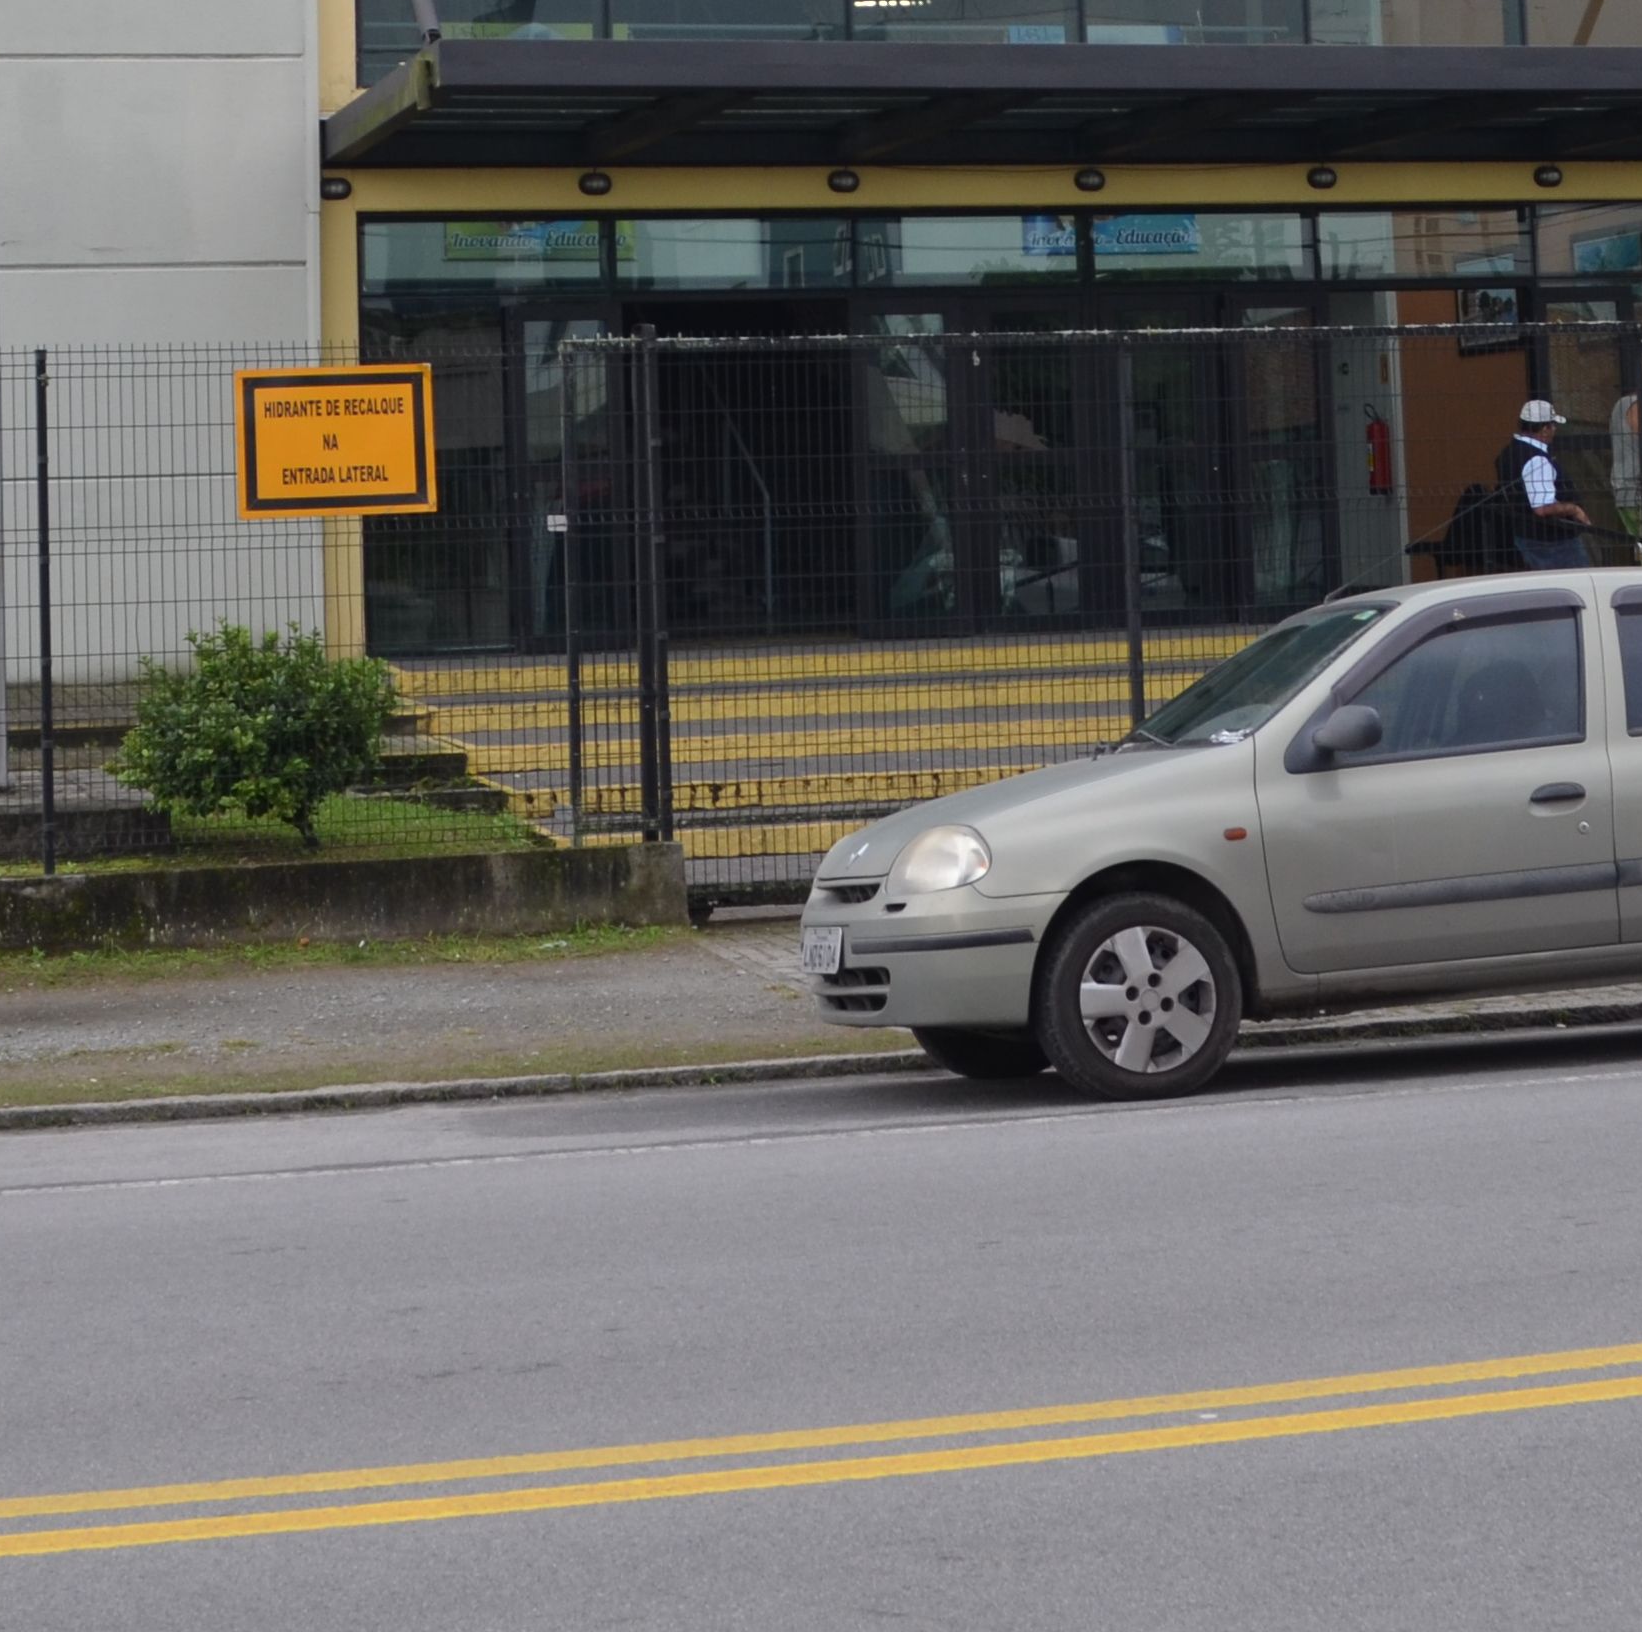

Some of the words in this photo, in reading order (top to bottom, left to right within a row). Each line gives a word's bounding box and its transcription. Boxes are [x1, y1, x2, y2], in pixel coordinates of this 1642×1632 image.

[544, 229, 627, 248] Educao
[264, 399, 323, 418] HIDRANTE
[326, 399, 340, 417] DE
[344, 397, 404, 416] RECALQUE
[322, 433, 339, 451] NA
[282, 467, 336, 485] ENTRADA
[339, 465, 389, 483] LATERAL
